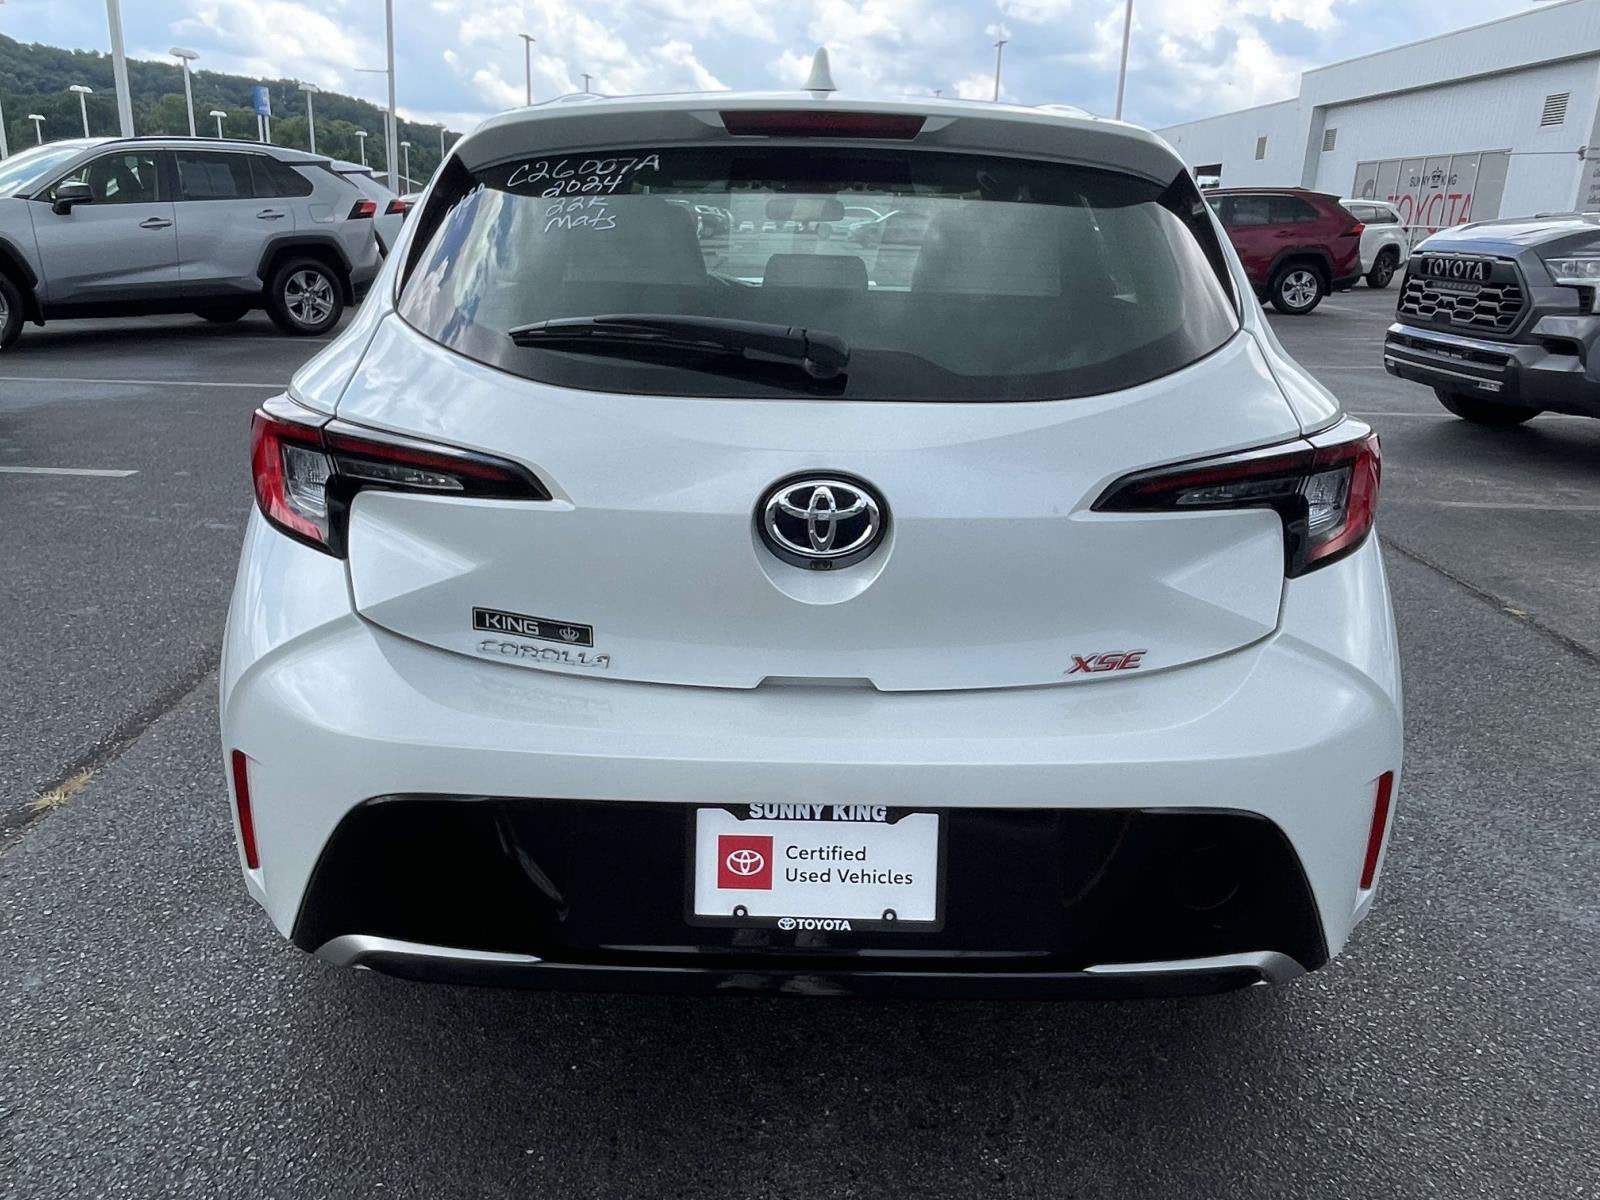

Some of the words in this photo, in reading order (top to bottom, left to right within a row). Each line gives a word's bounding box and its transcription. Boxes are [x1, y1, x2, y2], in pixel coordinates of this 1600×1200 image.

[541, 175, 623, 198] 2024
[1441, 174, 1458, 186] KNG
[1388, 194, 1471, 235] OYOTA
[1427, 258, 1484, 280] TOYOTA
[485, 613, 540, 635] KING
[477, 640, 611, 669] COROLLA
[1064, 648, 1148, 674] XSE
[749, 803, 825, 820] SUNNY
[832, 804, 887, 821] KING
[786, 846, 866, 861] Certified
[786, 868, 831, 883] Used
[837, 869, 913, 885] Vehicles
[797, 919, 851, 931] TOYOTA
